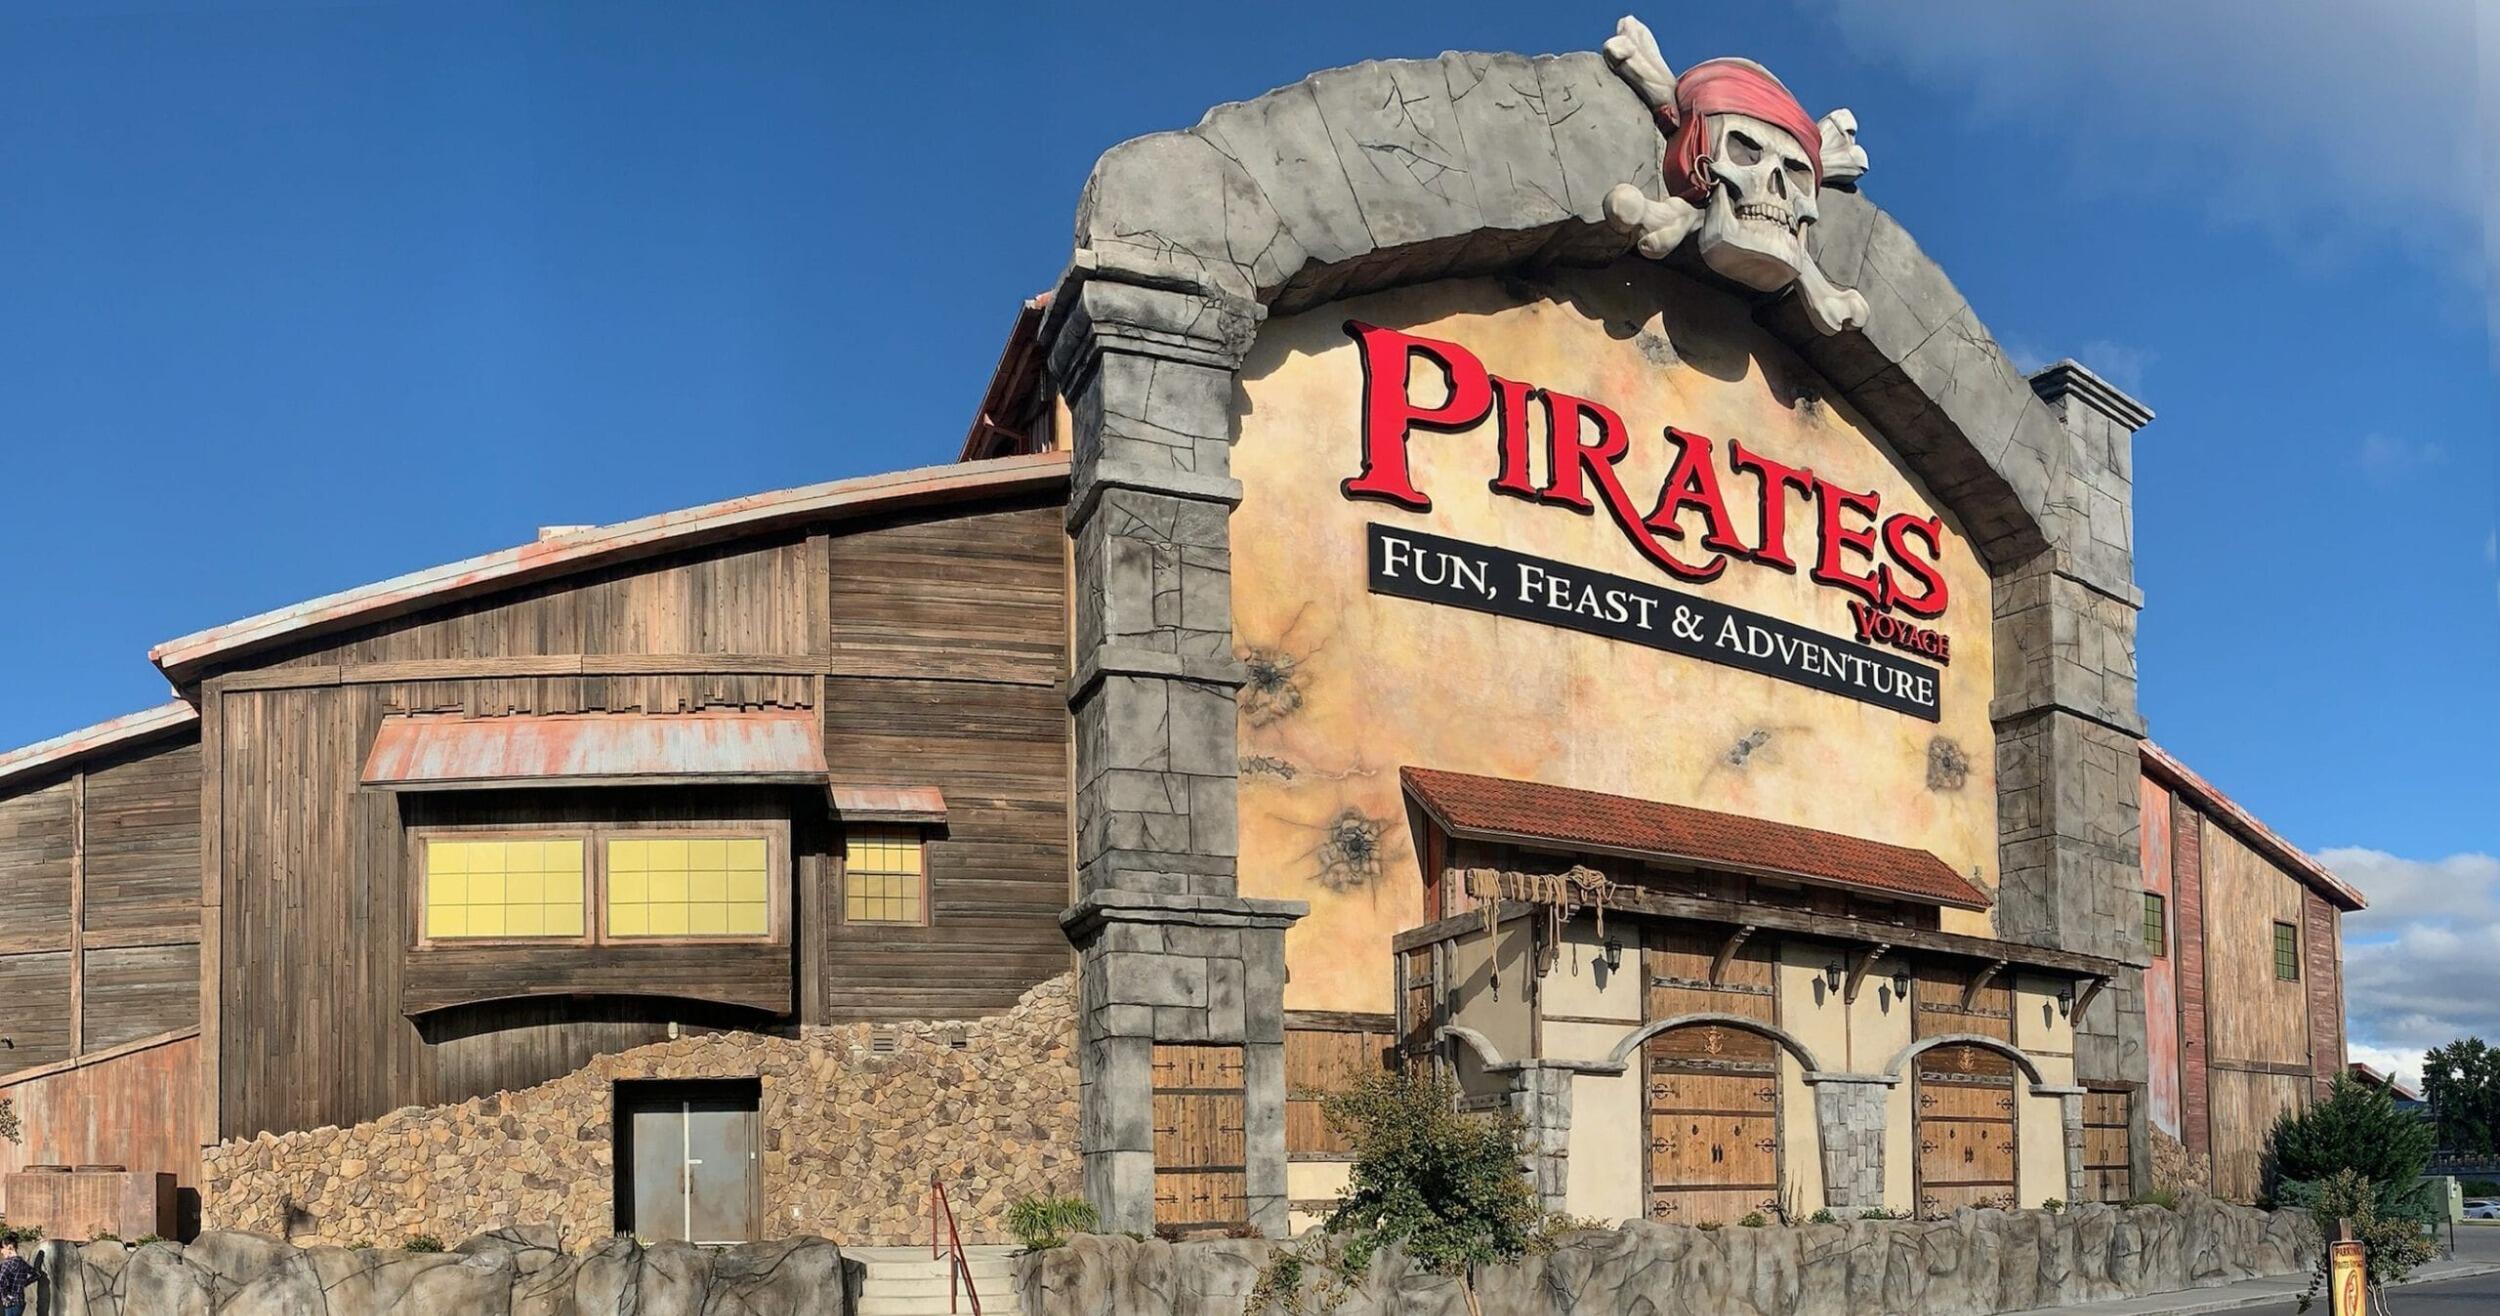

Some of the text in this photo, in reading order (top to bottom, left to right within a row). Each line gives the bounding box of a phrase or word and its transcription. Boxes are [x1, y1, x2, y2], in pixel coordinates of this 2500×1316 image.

[1341, 320, 1949, 619] PIRATES
[1381, 536, 1935, 706] FUN, FEAST & ADVENTURE
[1848, 601, 1950, 663] VOYAGE
